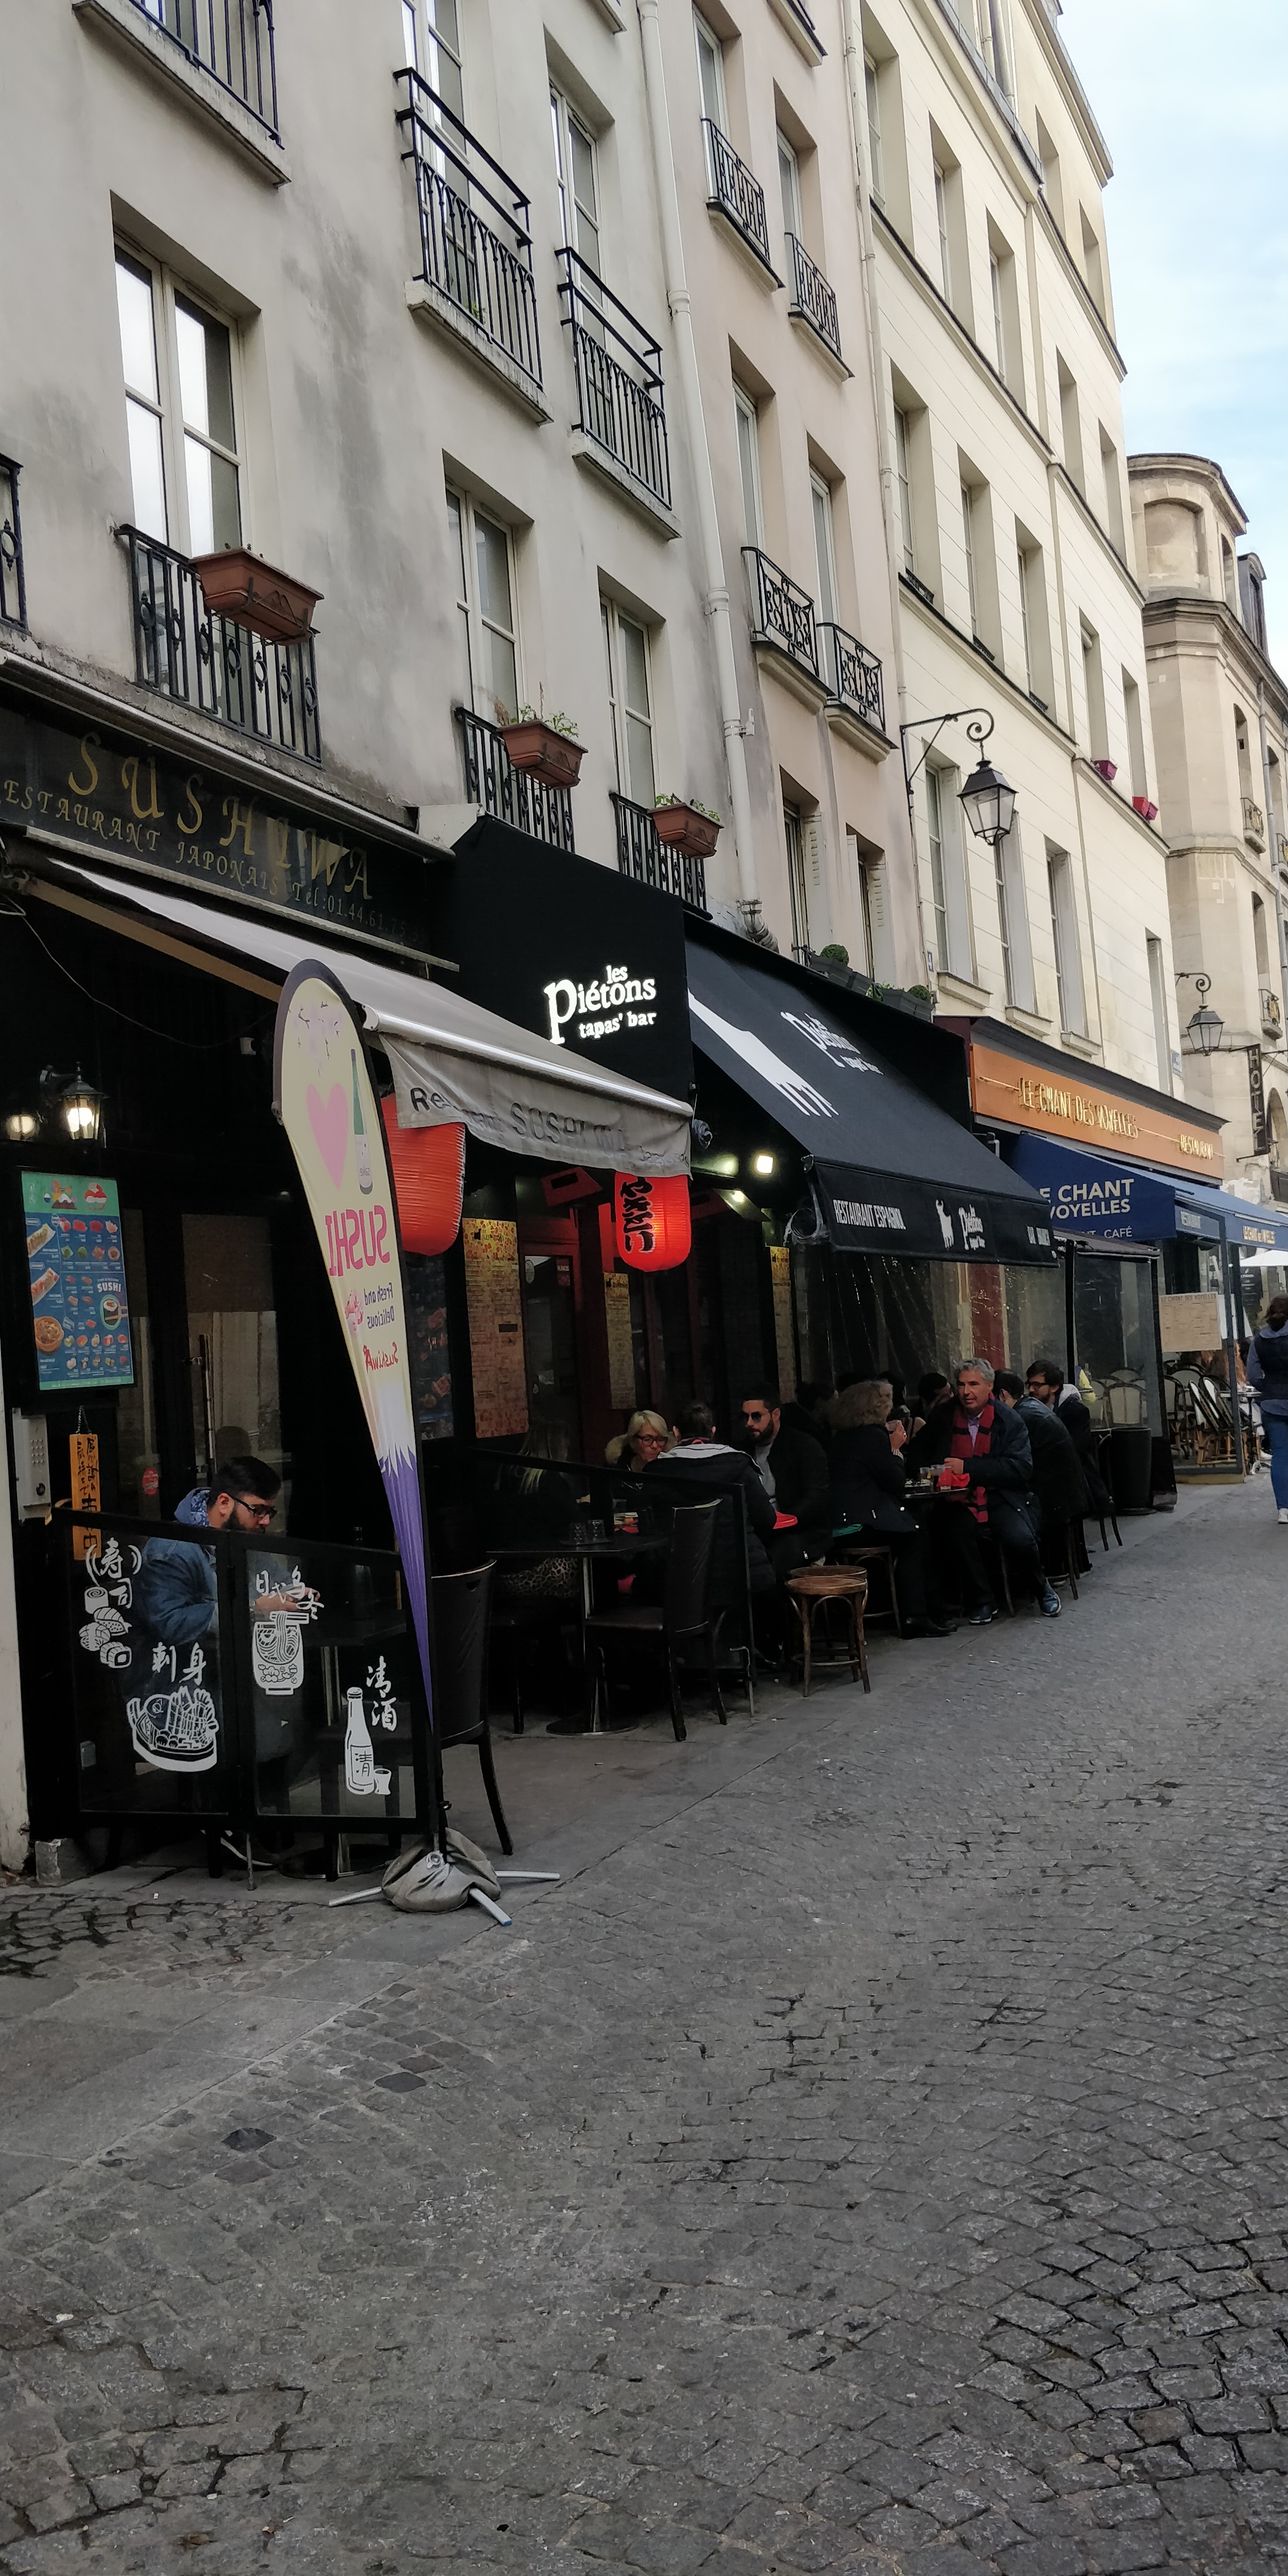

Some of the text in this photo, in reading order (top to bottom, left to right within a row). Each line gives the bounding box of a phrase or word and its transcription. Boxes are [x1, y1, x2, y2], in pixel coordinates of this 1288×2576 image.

[68, 731, 373, 901] SUSHIWA
[0, 779, 160, 853] ESTAURANT
[175, 841, 278, 895] JAPONAIS
[605, 964, 629, 984] les
[626, 1011, 657, 1027] bar
[1020, 1077, 1139, 1139] LE CHANT DES VOYELLES
[1180, 1134, 1214, 1160] RESTAURANT
[1057, 1178, 1135, 1203] CHANT
[832, 1199, 907, 1230] RESTAURANT ESPAGNOL
[1104, 1225, 1133, 1239] CAFÉ
[97, 1281, 122, 1293] SUSHI
[151, 1641, 207, 1687] 刺身
[366, 1655, 398, 1732] 清酒
[354, 1750, 373, 1778] 清
